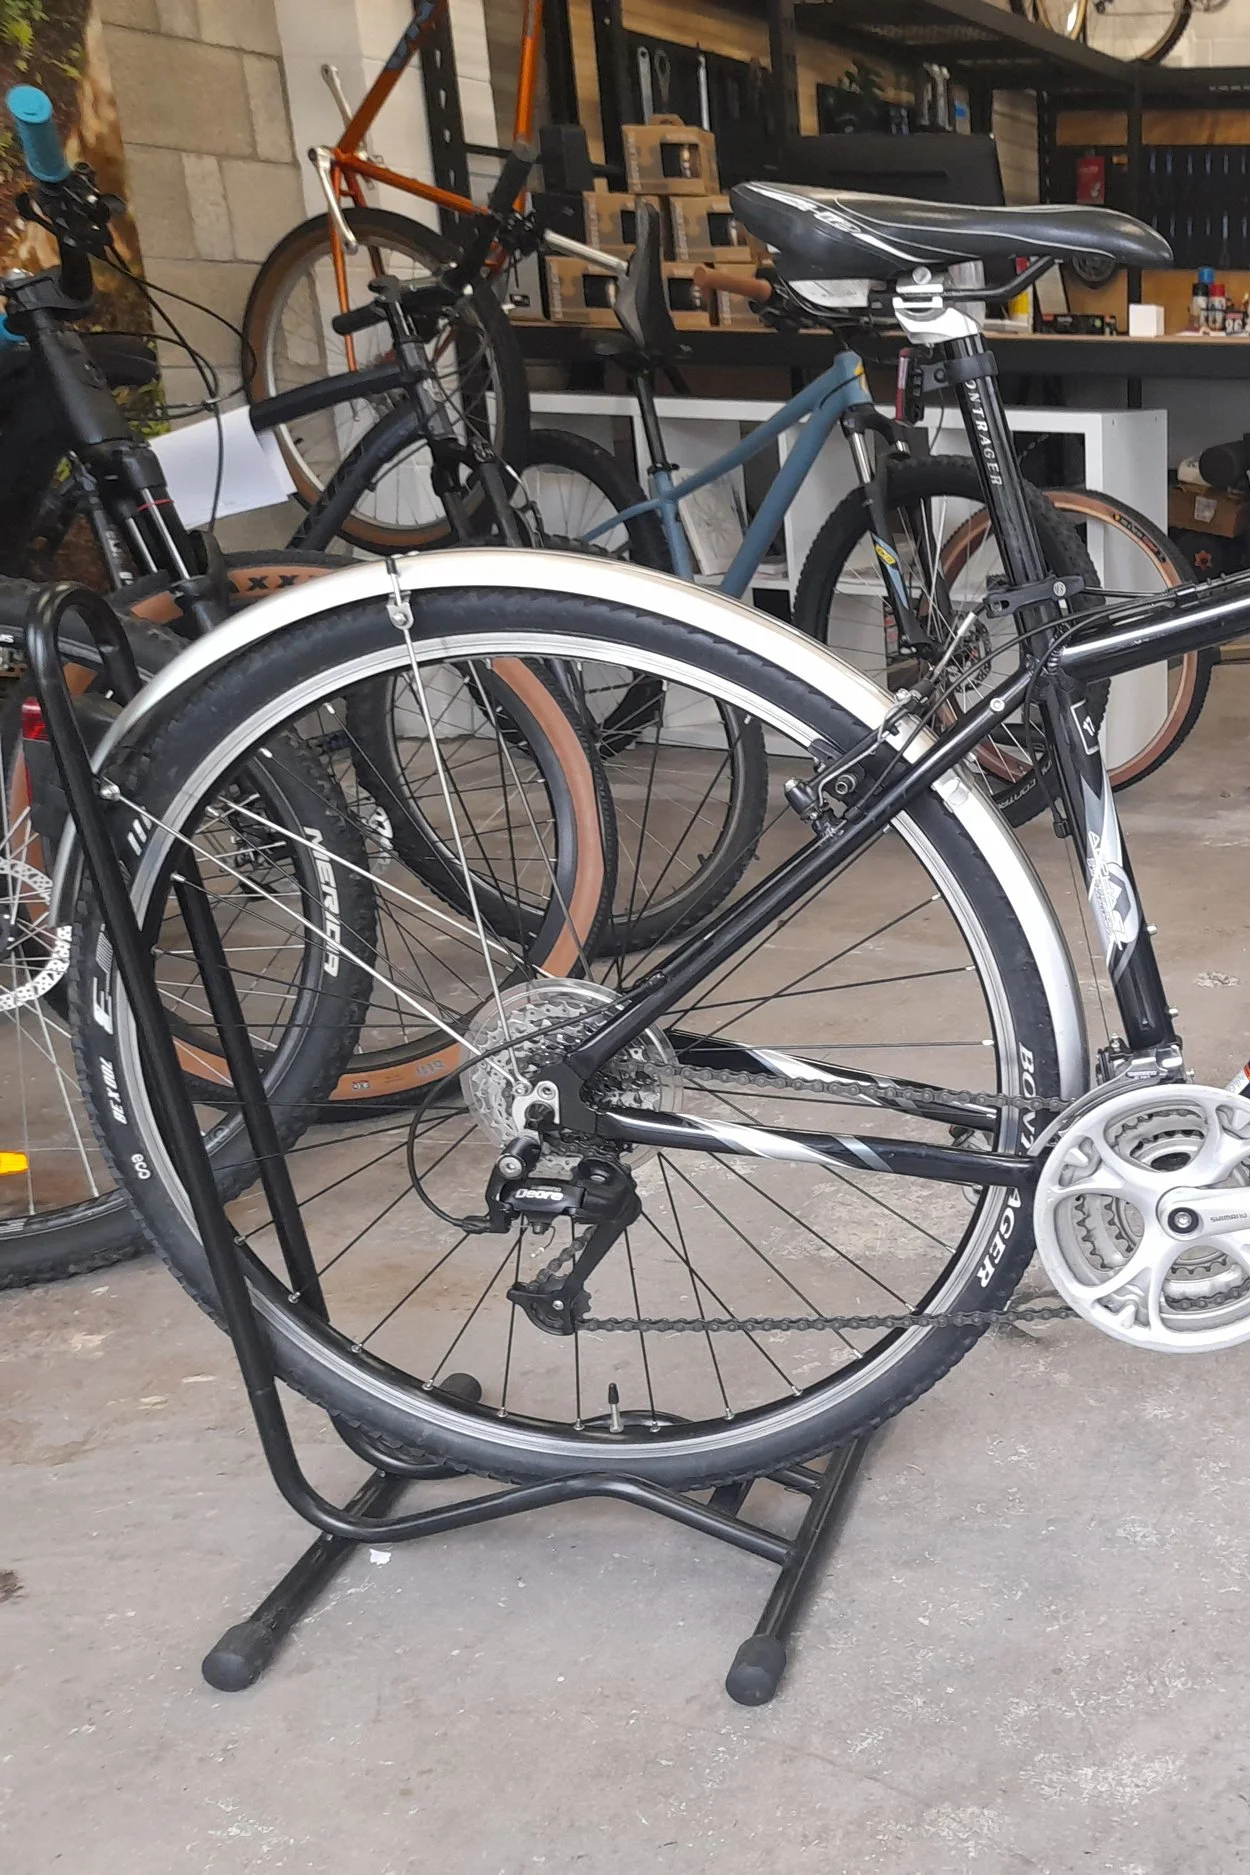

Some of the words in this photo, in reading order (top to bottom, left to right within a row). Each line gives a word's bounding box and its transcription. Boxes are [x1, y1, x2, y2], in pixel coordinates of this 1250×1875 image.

[965, 379, 1002, 486] ONTRAGER
[1082, 715, 1096, 737] 17
[515, 1188, 564, 1201] Deore
